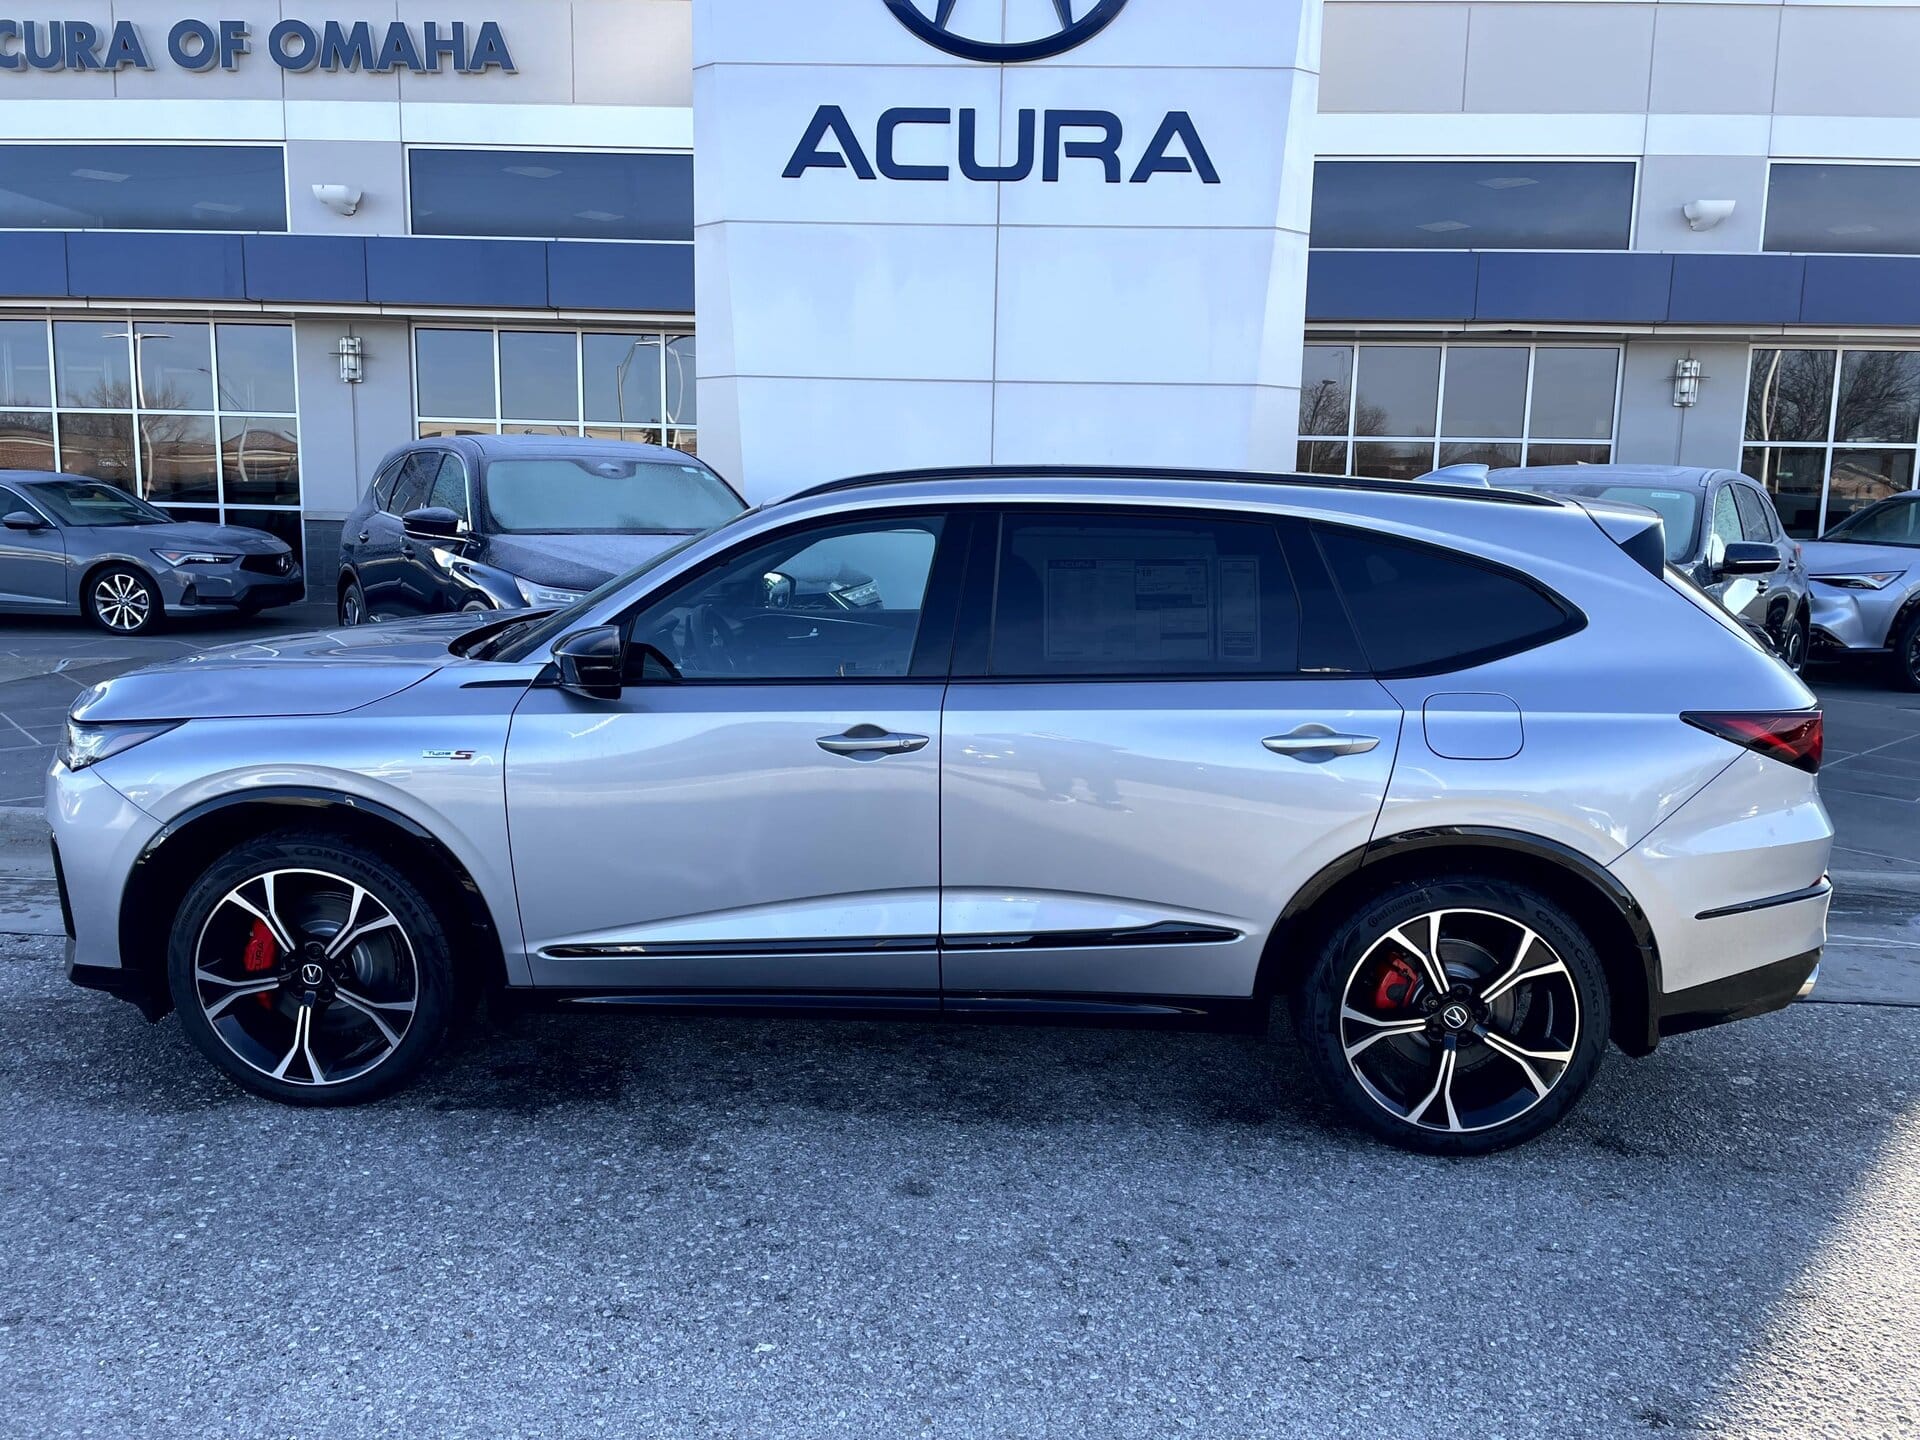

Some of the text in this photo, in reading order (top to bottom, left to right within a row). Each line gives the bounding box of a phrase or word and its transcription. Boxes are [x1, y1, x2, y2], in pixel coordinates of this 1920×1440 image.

[167, 19, 251, 71] OF
[268, 19, 519, 74] OMAHA
[781, 104, 1221, 184] ACURA
[450, 750, 476, 760] S
[293, 845, 420, 920] CONTINENTAL
